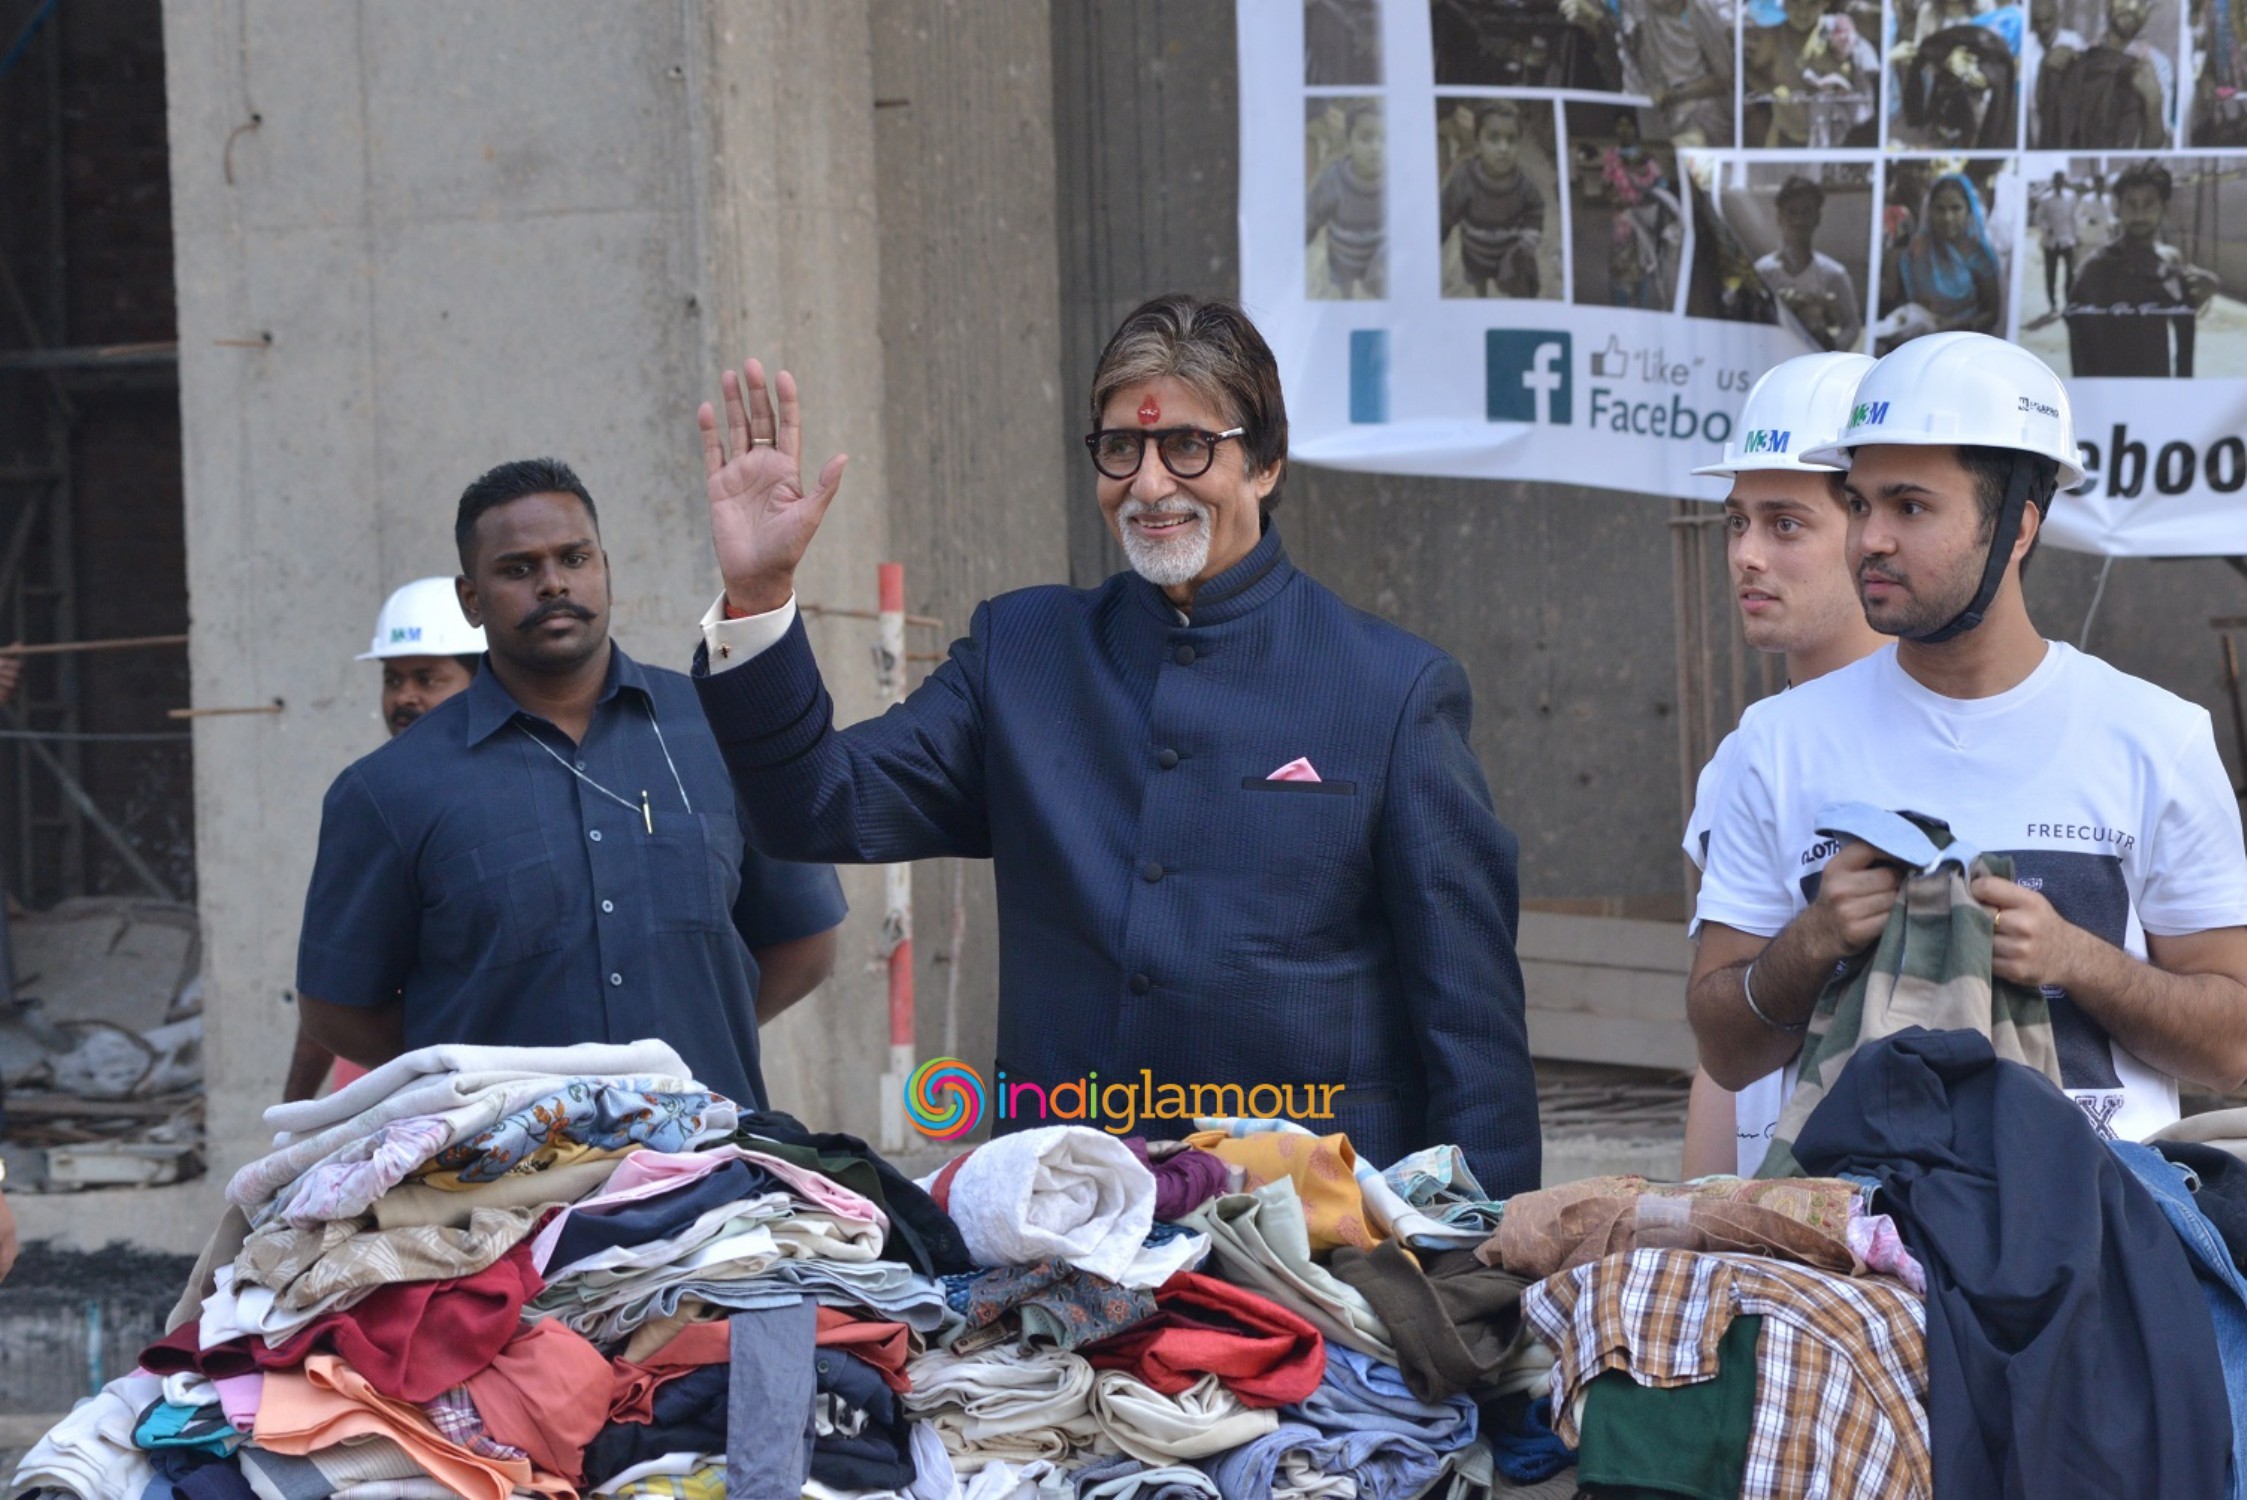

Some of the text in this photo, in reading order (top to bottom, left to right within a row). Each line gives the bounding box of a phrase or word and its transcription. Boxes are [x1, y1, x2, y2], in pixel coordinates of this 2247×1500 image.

[1716, 368, 1749, 393] us
[1590, 387, 1732, 444] Facebo
[2066, 423, 2247, 498] eboo
[2027, 823, 2136, 850] FREECULTR
